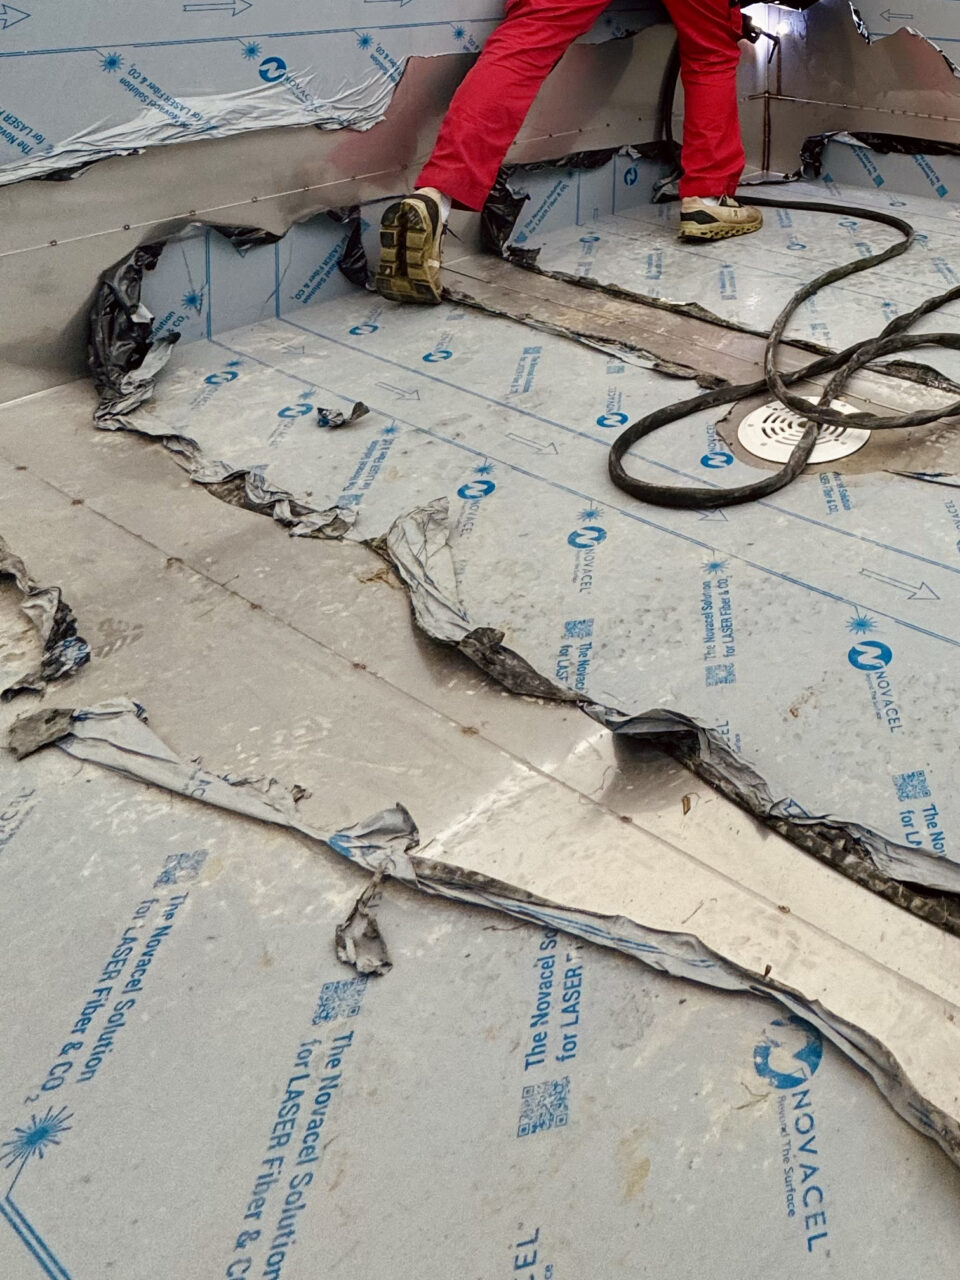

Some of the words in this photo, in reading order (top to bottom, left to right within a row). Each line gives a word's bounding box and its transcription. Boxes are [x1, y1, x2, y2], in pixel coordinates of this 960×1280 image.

[2, 110, 33, 135] LASER
[605, 386, 616, 416] NOVACEL
[578, 548, 594, 594] NOVACEL
[700, 580, 713, 612] Solution
[718, 596, 731, 616] Fiber
[701, 611, 715, 643] Novacel
[720, 616, 734, 644] LASER
[703, 644, 716, 660] The
[876, 670, 902, 733] NOVACEL
[900, 810, 916, 832] for
[922, 804, 940, 828] The
[131, 898, 159, 920] for
[161, 891, 188, 921] The
[97, 924, 144, 983] LASER
[120, 924, 173, 994] Novacel
[529, 954, 556, 1028] Novacel
[560, 964, 583, 1028] LASER
[69, 985, 112, 1034] Fiber
[75, 998, 136, 1083] Solution
[293, 1038, 322, 1068] for
[324, 1029, 354, 1069] The
[524, 1030, 548, 1071] The
[555, 1033, 578, 1062] for
[266, 1072, 310, 1151] LASER
[295, 1071, 342, 1166] Novacel
[243, 1155, 284, 1220] Fiber
[791, 1088, 828, 1252] NOVACEL
[233, 1228, 261, 1252] &
